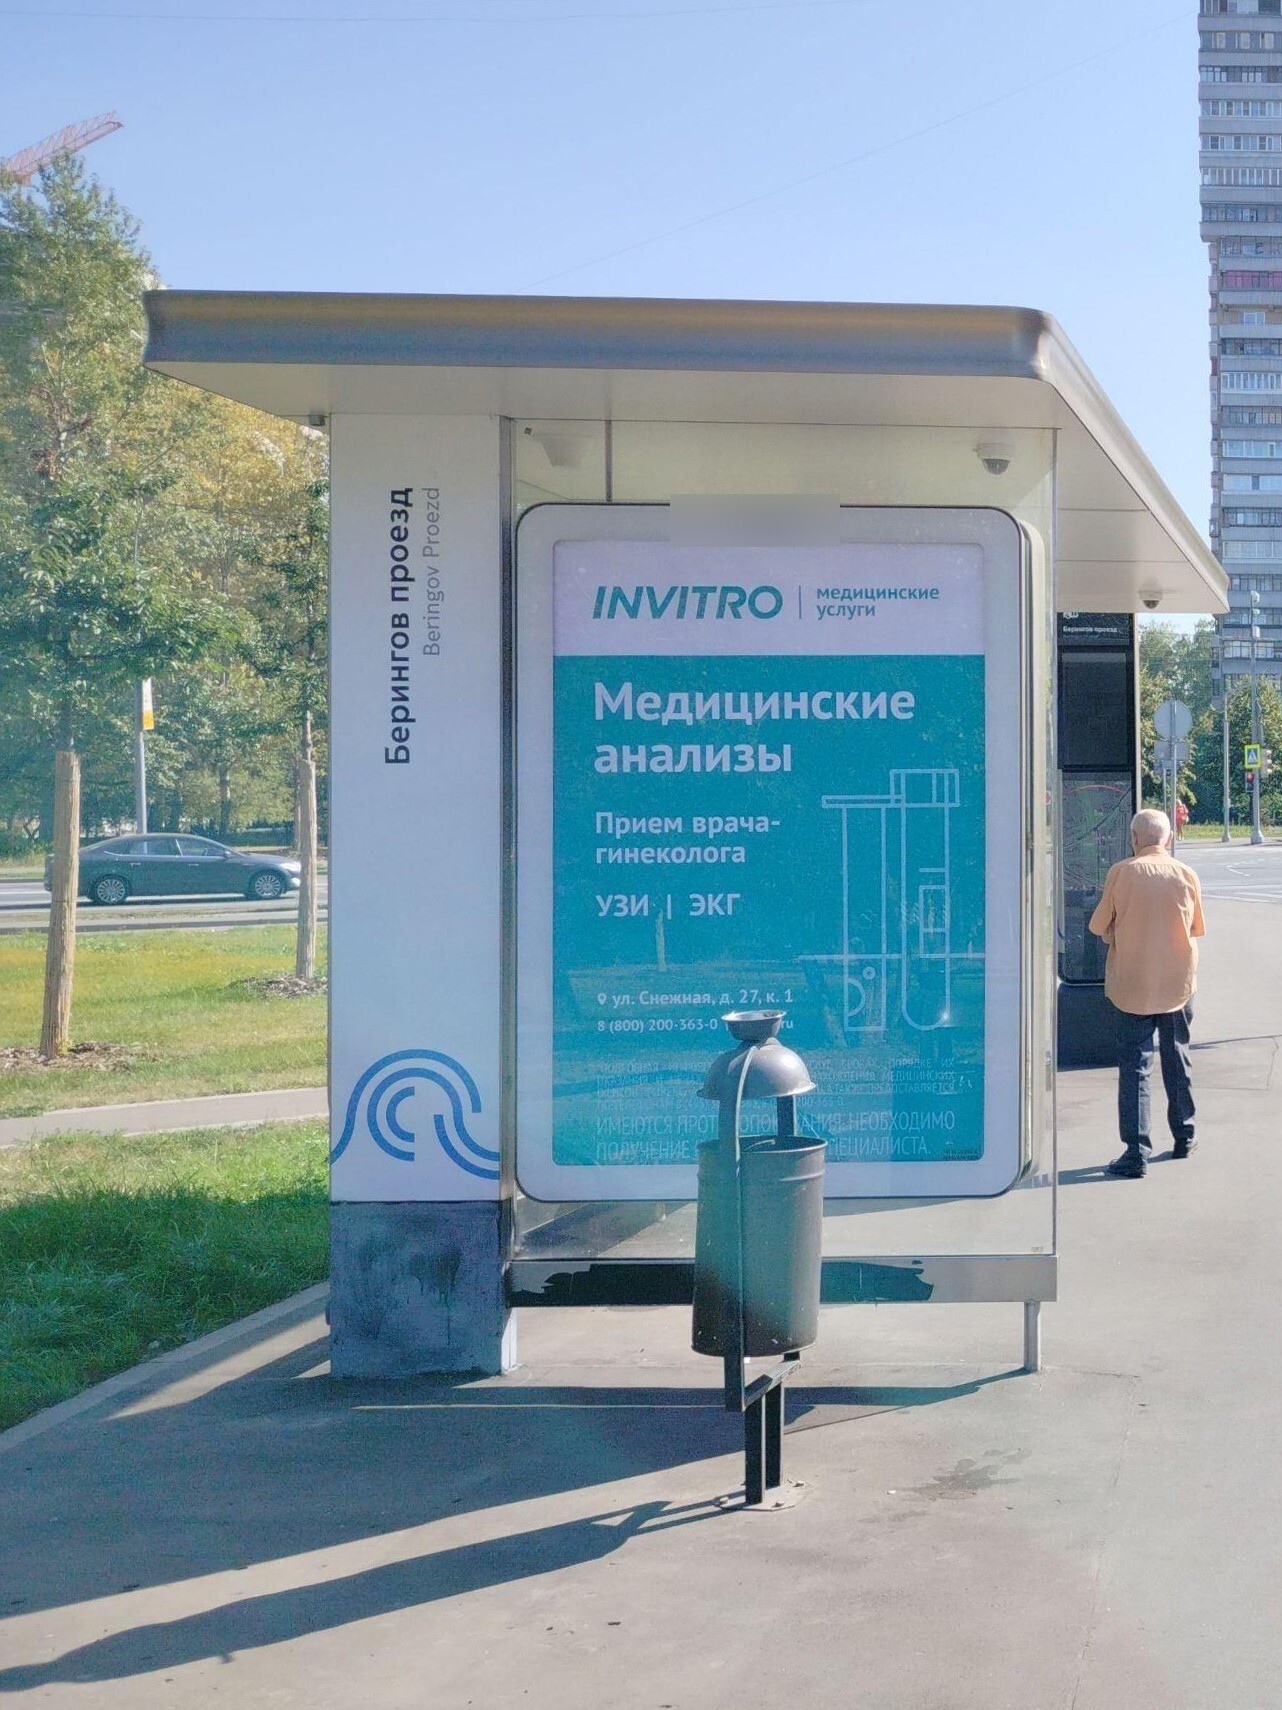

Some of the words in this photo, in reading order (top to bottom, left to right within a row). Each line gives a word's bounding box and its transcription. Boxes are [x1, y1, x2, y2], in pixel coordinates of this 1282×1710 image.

[421, 487, 440, 558] Proezd
[390, 487, 415, 602] проезд
[592, 585, 784, 620] INVITRO
[816, 585, 940, 602] медицинские
[423, 565, 445, 656] Beringov
[816, 602, 876, 620] услуги
[385, 612, 416, 764] Берингов
[594, 681, 916, 726] Медицинские
[593, 743, 792, 774] анализы
[595, 811, 683, 839] Прием
[692, 815, 781, 838] врача-
[596, 846, 746, 864] гинеколога
[595, 894, 649, 917] УЗИ
[689, 893, 741, 916] ЭКГ
[612, 994, 635, 1009] ул.
[639, 990, 716, 1006] Снежная,
[719, 992, 734, 1006] д.
[739, 989, 762, 1005] 27,
[766, 991, 780, 1003] к.
[784, 989, 793, 1003] 1
[597, 1020, 606, 1032] 8
[609, 1018, 644, 1034] (800)
[648, 1018, 718, 1032] 200-363-0
[597, 1115, 672, 1135] ИМЕЮТСЯ
[848, 1110, 955, 1133] НЕОБХОДИМО
[597, 1139, 691, 1160] ПОЛУЧЕНИЕ
[826, 1136, 931, 1158] ПЕЦИАЛИСТА.
